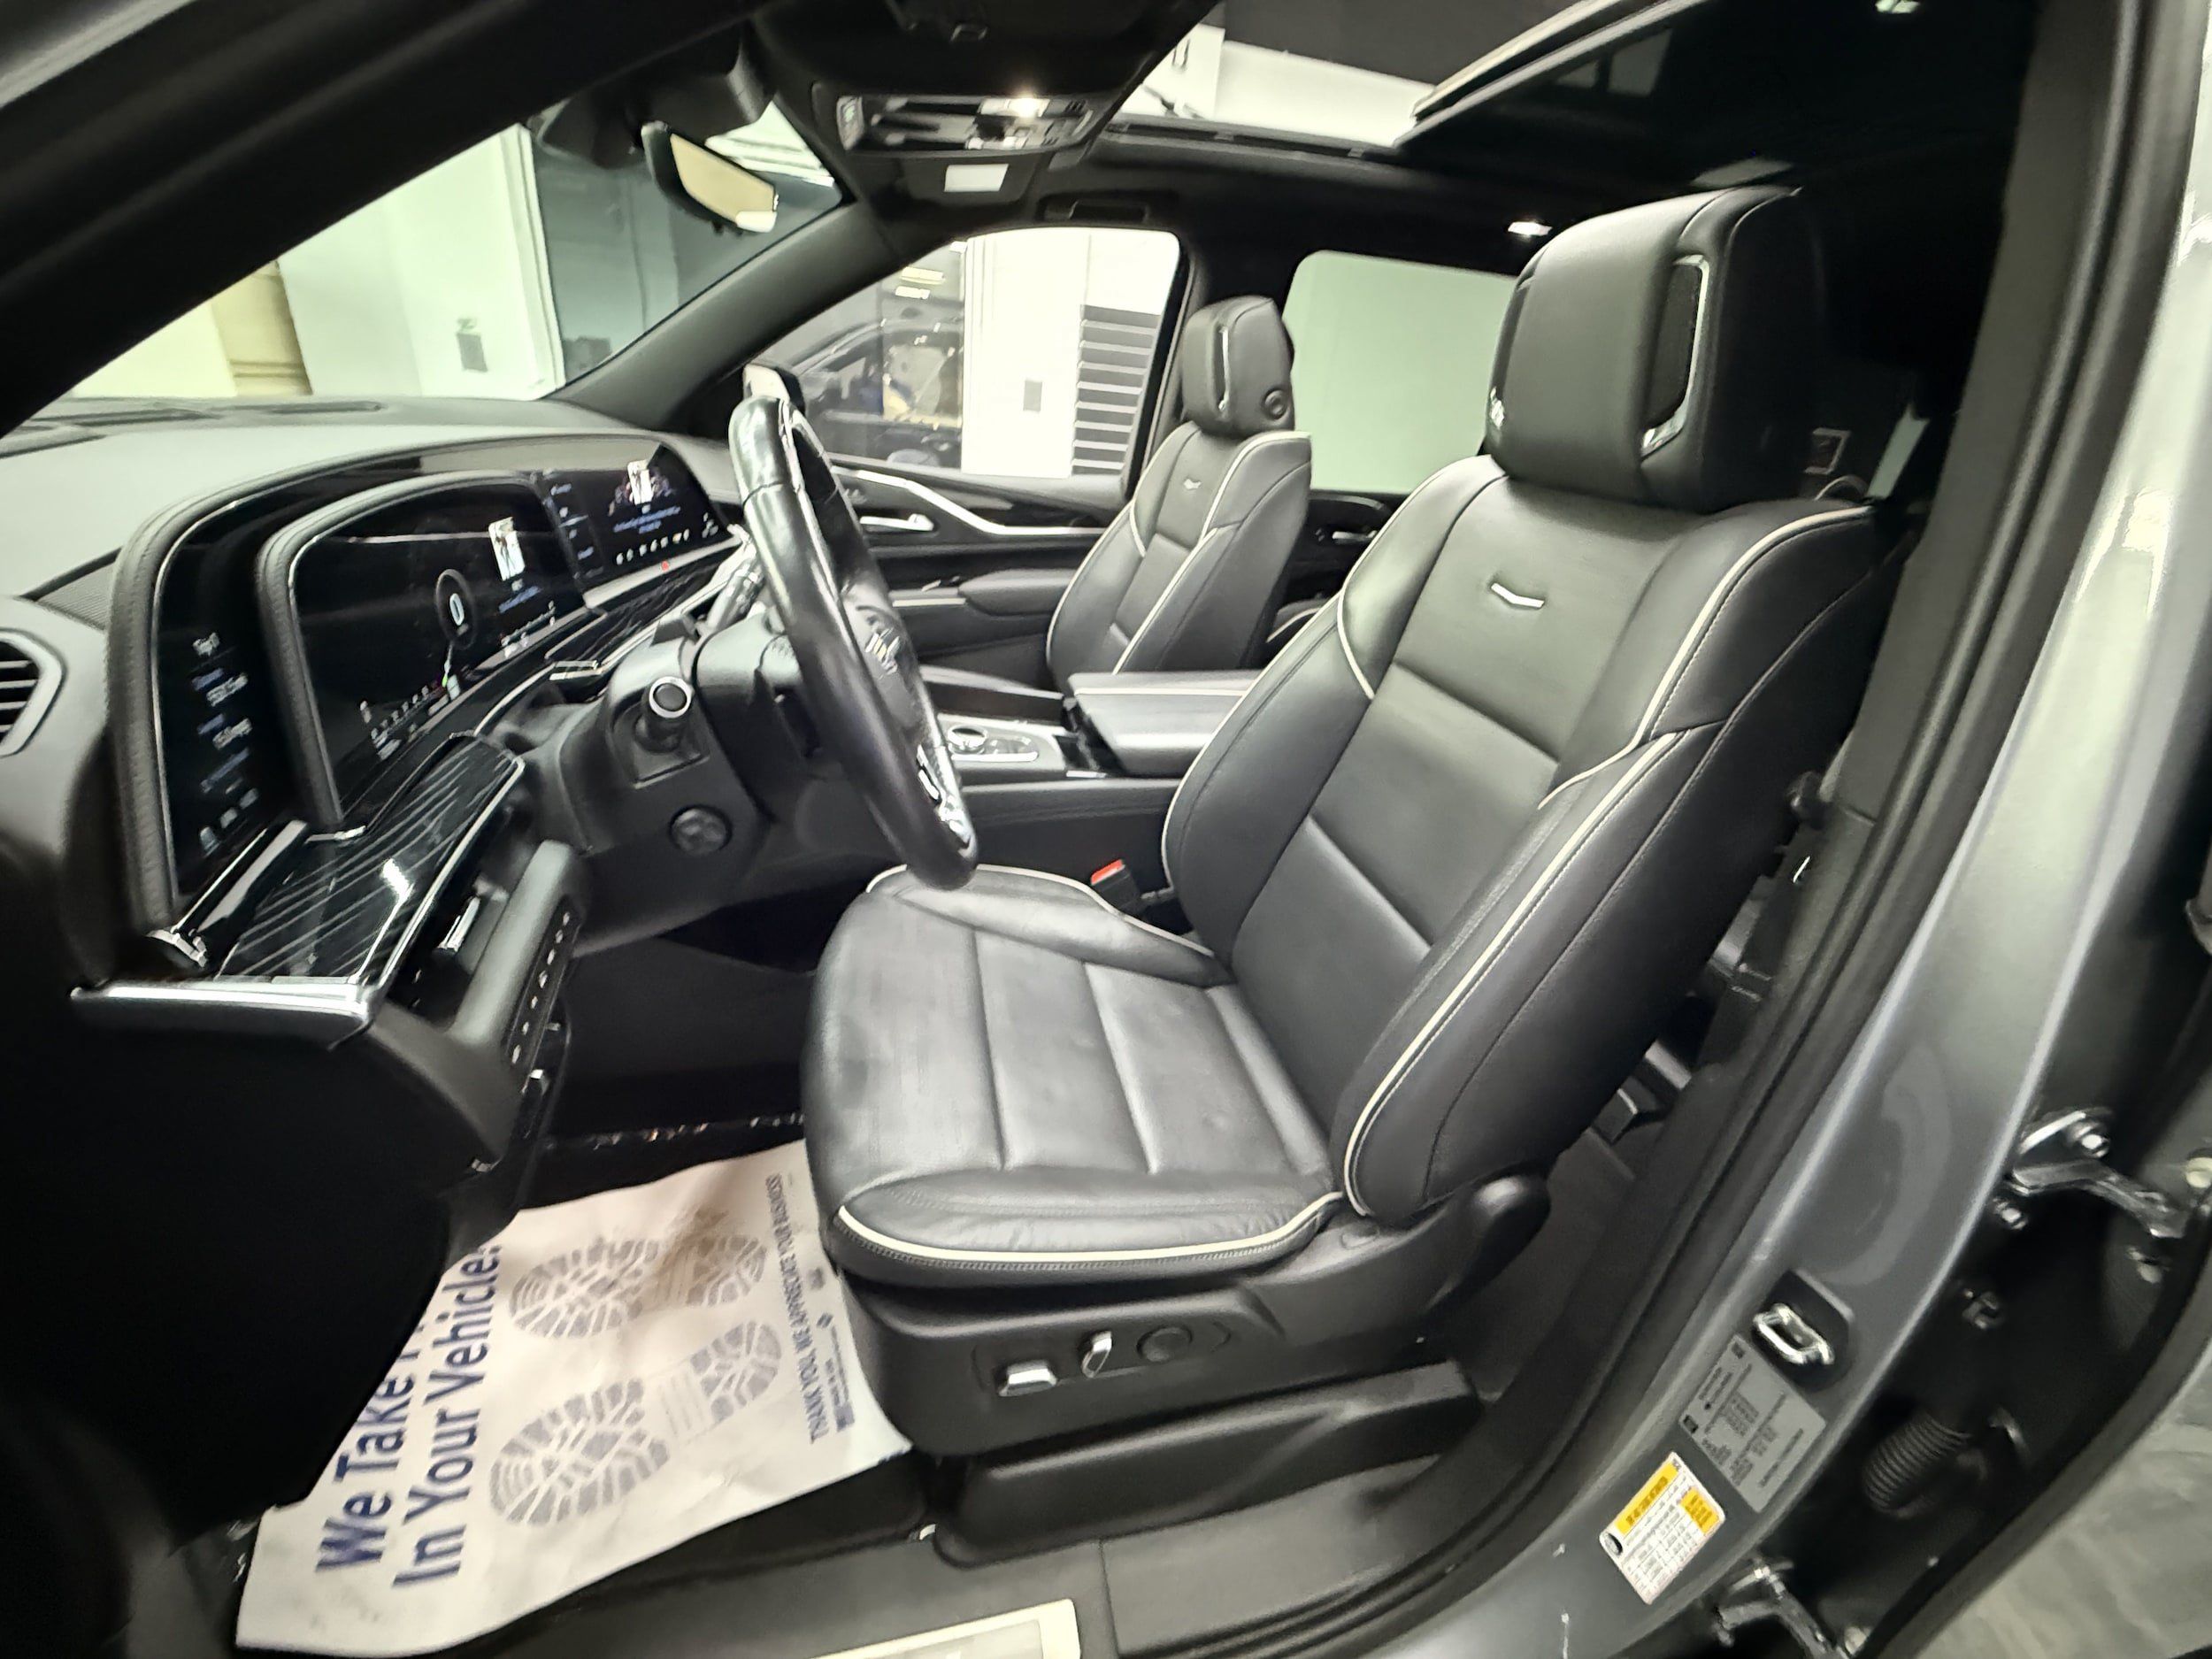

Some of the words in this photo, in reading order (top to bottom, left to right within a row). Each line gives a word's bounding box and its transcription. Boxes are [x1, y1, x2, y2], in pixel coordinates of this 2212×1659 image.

[333, 1374, 415, 1483] Take
[803, 1384, 830, 1444] THANK
[403, 1408, 481, 1525] Your
[316, 1492, 392, 1572] We
[392, 1524, 467, 1587] In
